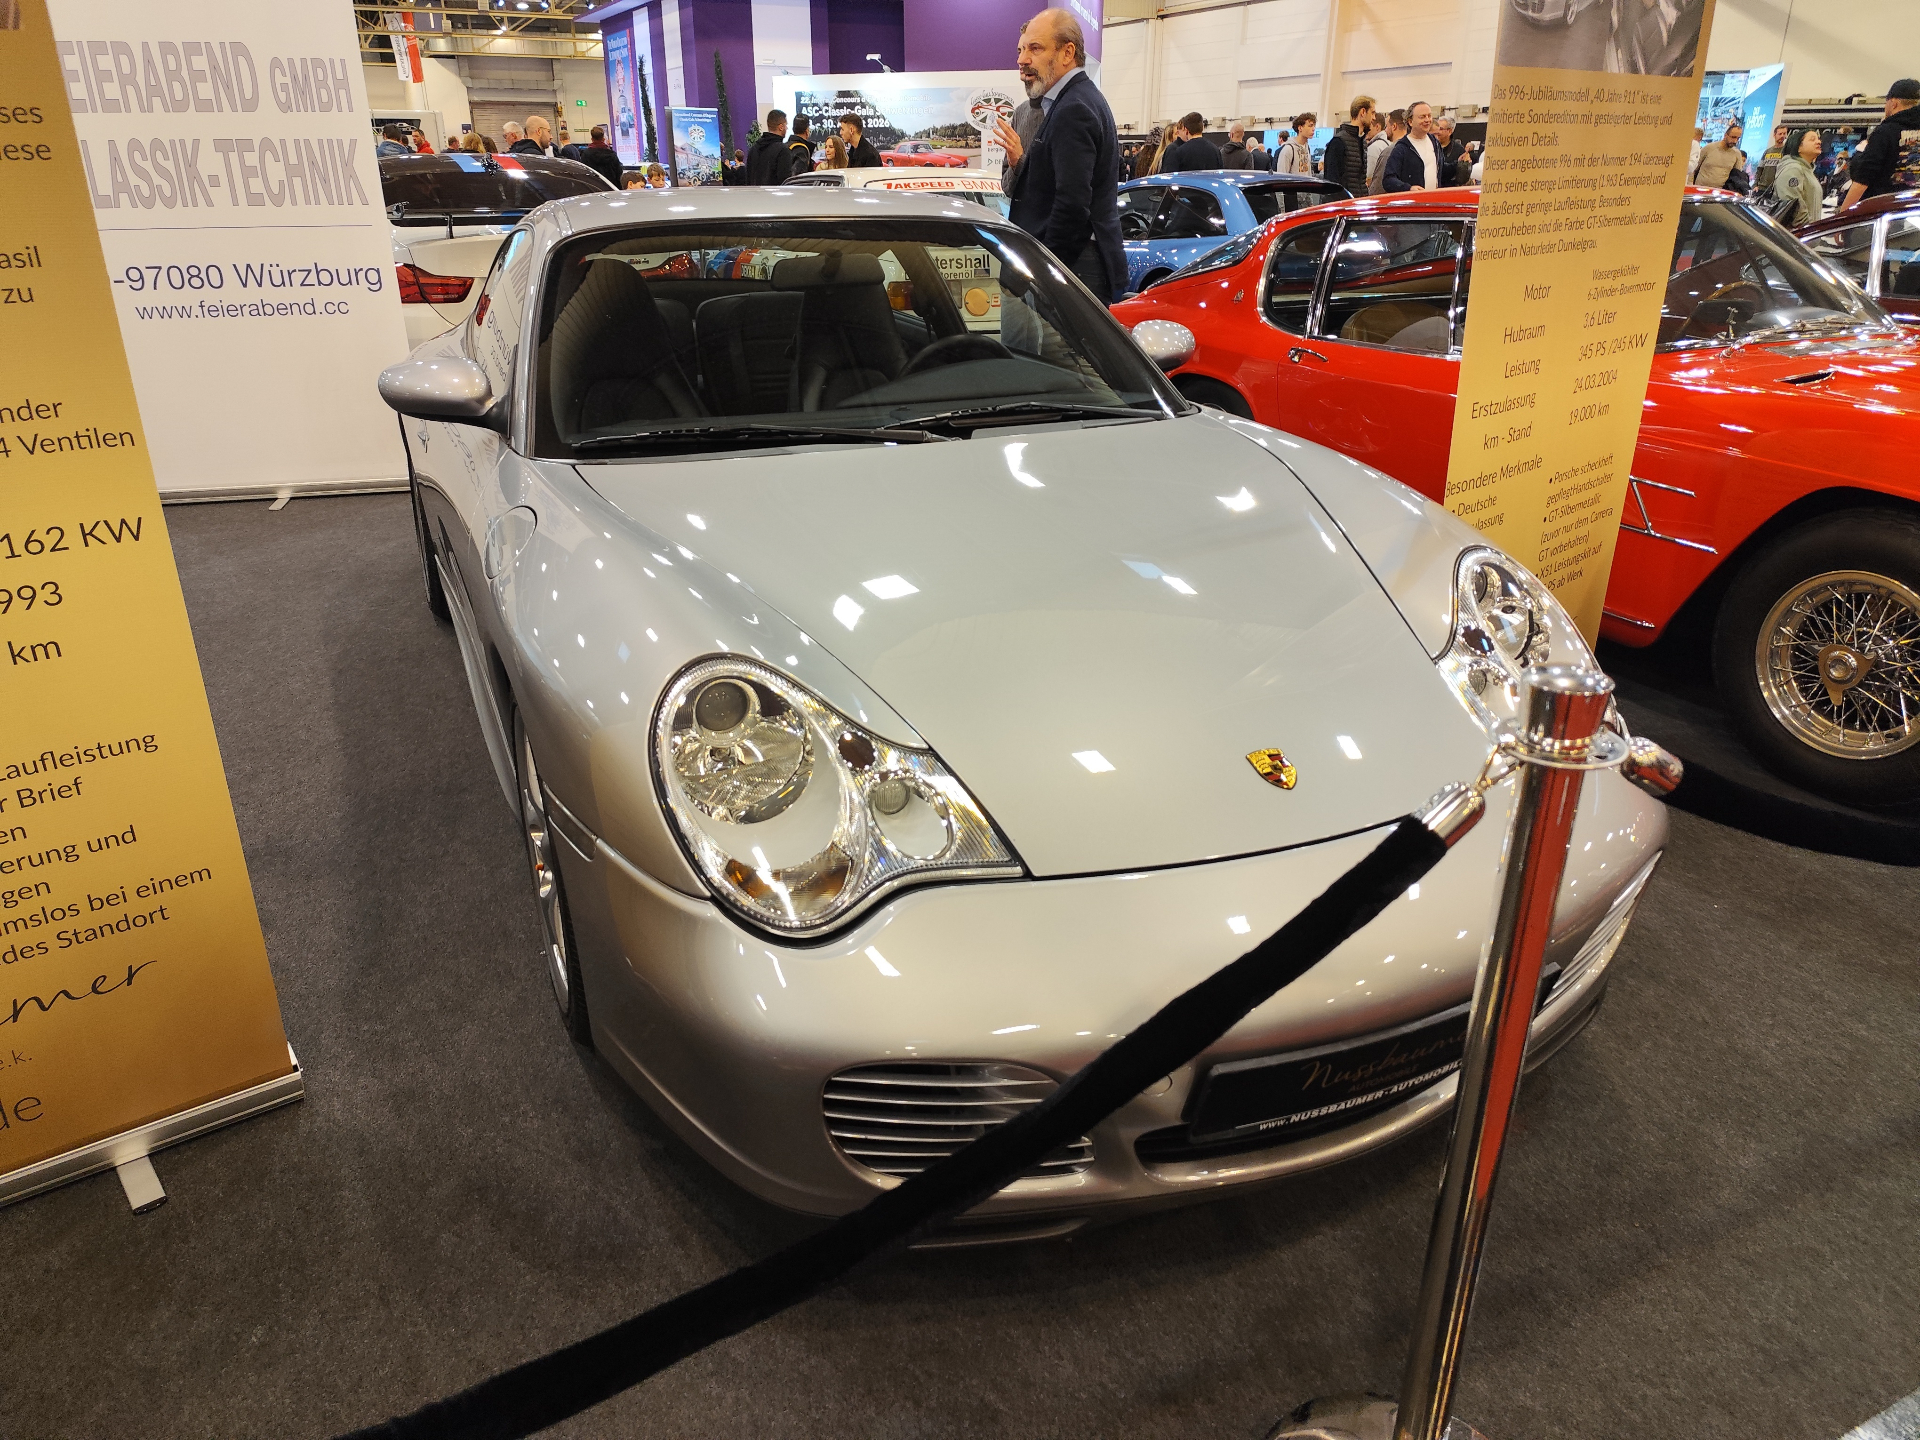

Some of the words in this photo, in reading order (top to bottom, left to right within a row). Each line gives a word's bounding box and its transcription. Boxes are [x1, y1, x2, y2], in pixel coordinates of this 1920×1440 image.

[269, 56, 354, 114] GMBH
[1493, 84, 1507, 100] Das
[1605, 88, 1622, 104] Jahre
[1640, 90, 1648, 105] ist
[1649, 94, 1662, 105] eine
[867, 118, 890, 128] 2026
[1526, 108, 1579, 125] Sonderedition
[1580, 110, 1593, 125] mit
[1594, 111, 1633, 128] gesteigerter
[1633, 112, 1659, 128] Leistung
[1659, 112, 1674, 126] und
[0, 143, 52, 161] ese
[1487, 132, 1529, 148] exklusiven
[1531, 131, 1560, 148] Details.
[80, 136, 370, 209] LASSIK-TECHNIK
[1485, 155, 1509, 171] Dieser
[1510, 154, 1558, 173] angebotene
[1559, 154, 1572, 168] 996
[1573, 153, 1586, 168] mit
[1587, 152, 1600, 168] der
[1601, 153, 1628, 167] Nummer
[1628, 152, 1642, 167] 194
[1642, 152, 1675, 169] überzeugt
[960, 179, 1002, 191] BMW
[1482, 178, 1505, 194] durch
[1504, 177, 1528, 193] seine
[1529, 178, 1557, 194] strenge
[1557, 175, 1598, 192] Limitierung
[1652, 171, 1667, 185] und
[1479, 201, 1489, 217] die
[1490, 200, 1525, 217] äußerst
[1525, 199, 1553, 217] geringe
[1598, 193, 1632, 209] Besonders
[1476, 221, 1537, 240] hervorzuheben
[1537, 218, 1552, 235] sind
[1552, 218, 1562, 233] die
[1564, 216, 1585, 232] Farbe
[1638, 211, 1651, 225] und
[1650, 210, 1664, 224] das
[935, 253, 990, 270] tershall
[1509, 244, 1518, 258] in
[1519, 240, 1557, 257] Naturleder
[113, 264, 225, 292] -97080
[233, 262, 383, 292] Würzburg
[1592, 264, 1641, 281] Wassergekühlter
[1, 286, 35, 304] zu
[1523, 283, 1552, 302] Motor
[1586, 281, 1657, 301] 6-Zylinder-Boxermotor
[134, 297, 350, 321] www.feierabend.cc
[1583, 310, 1596, 330] 3,6
[1597, 309, 1618, 326] Liter
[1503, 324, 1546, 345] Hubraum
[1578, 342, 1594, 362] 345
[1594, 340, 1607, 357] PS
[1627, 332, 1649, 350] KW
[1504, 358, 1541, 379] Leistung
[1573, 368, 1618, 394] 24.03.2004
[0, 398, 63, 424] nder
[1471, 392, 1537, 420] Erstzulassung
[1568, 403, 1597, 426] 19.000
[1597, 401, 1610, 418] km
[16, 427, 136, 456] Ventilen
[1483, 433, 1499, 451] km
[1506, 420, 1533, 444] Stand
[1445, 471, 1498, 498] Besondere
[1499, 453, 1543, 481] Merkmale
[1553, 465, 1580, 485] Porsche
[1580, 452, 1614, 475] scheckheft
[1457, 494, 1498, 517] Deutsche
[0, 525, 70, 560] 162
[78, 516, 143, 548] KW
[1540, 527, 1562, 546] (zuvor
[1561, 522, 1575, 535] nur
[1574, 516, 1589, 530] dem
[1590, 507, 1614, 524] Carrera
[1538, 547, 1550, 563] GT
[1549, 529, 1590, 558] vorbehalten)
[1553, 546, 1592, 573] Leistungskit
[1591, 540, 1603, 556] auf
[1556, 574, 1566, 589] ab
[1566, 566, 1584, 584] Werk
[7, 640, 63, 666] km
[16, 776, 83, 809] Brief
[0, 843, 81, 876] erung
[87, 824, 138, 853] und
[0, 903, 81, 937] mslos
[87, 885, 129, 912] bei
[136, 867, 213, 899] einem
[56, 904, 171, 950] Standort
